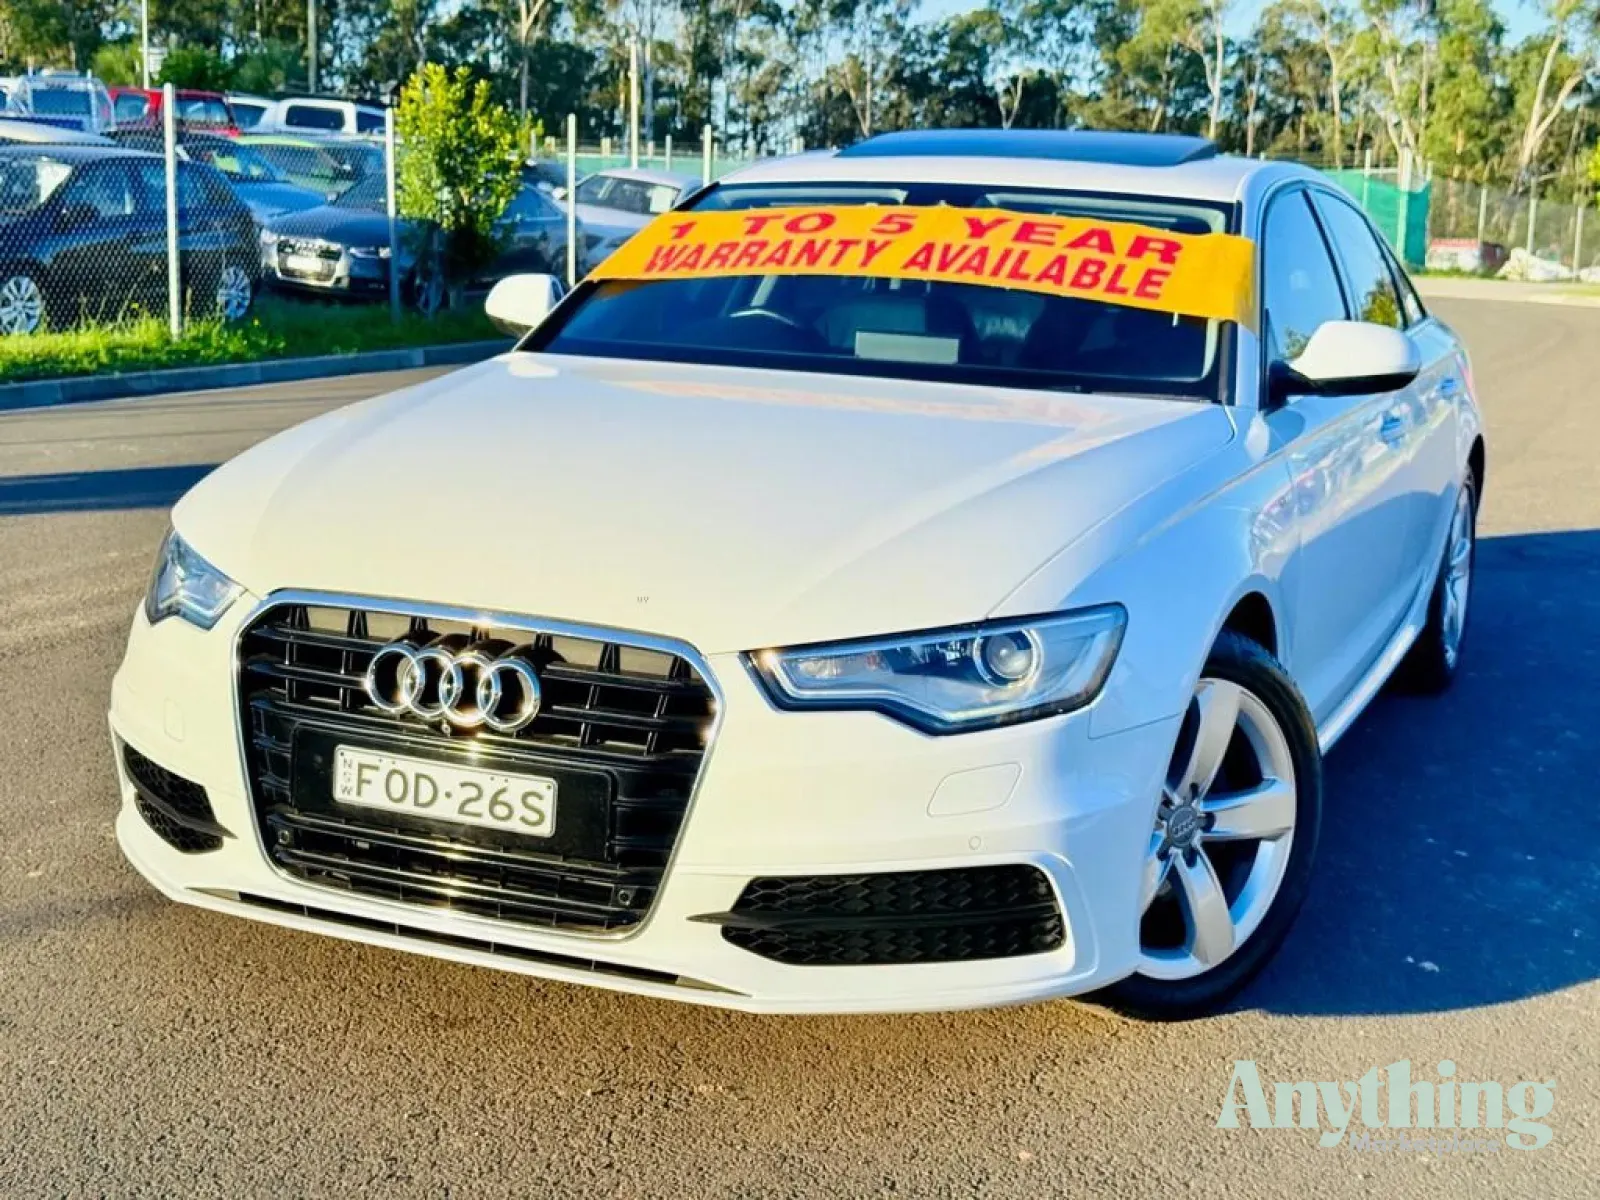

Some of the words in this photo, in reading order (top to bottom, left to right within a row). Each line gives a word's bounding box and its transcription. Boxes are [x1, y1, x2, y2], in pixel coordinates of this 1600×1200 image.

[670, 220, 697, 240] 1
[743, 212, 838, 236] TO
[870, 213, 918, 235] 5
[962, 215, 1183, 267] YEAR
[644, 238, 892, 274] WARRANTY
[900, 241, 1172, 301] AVAILABLE
